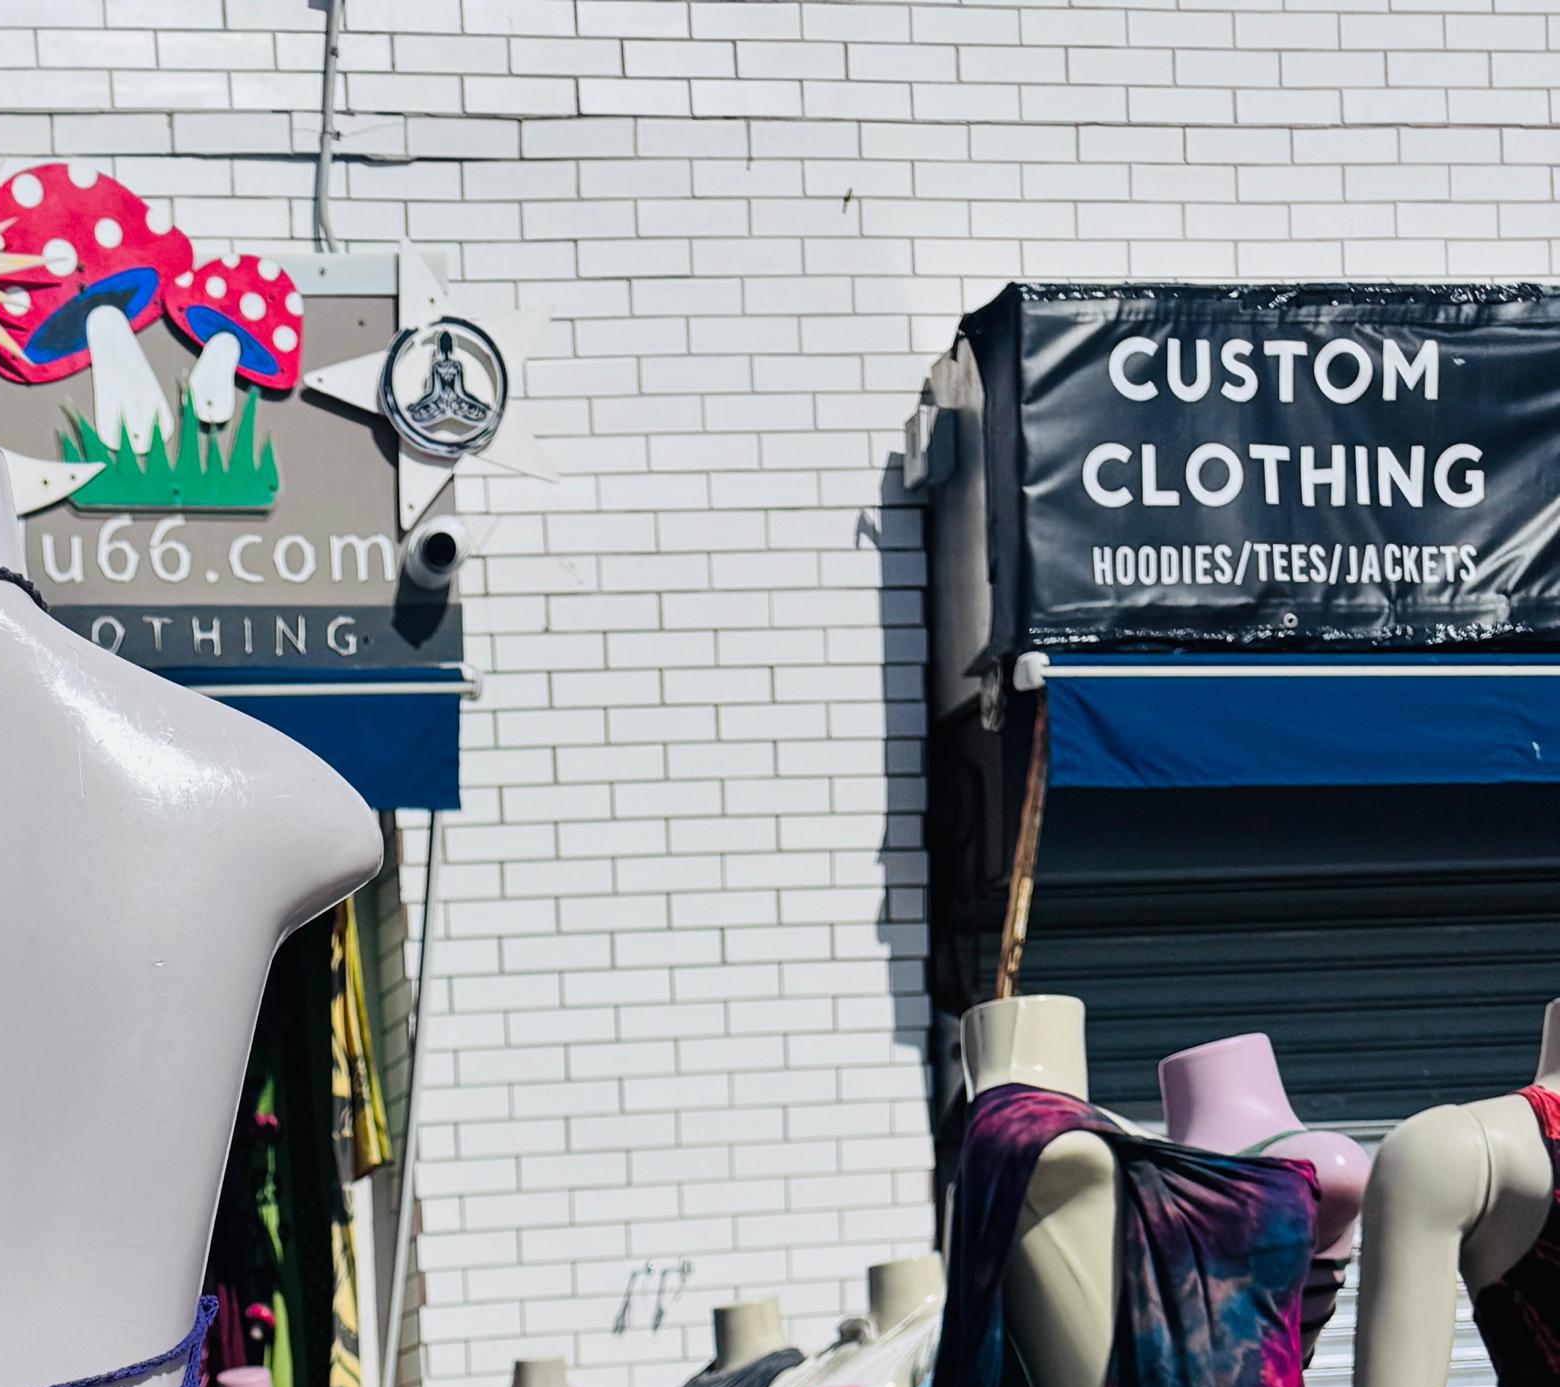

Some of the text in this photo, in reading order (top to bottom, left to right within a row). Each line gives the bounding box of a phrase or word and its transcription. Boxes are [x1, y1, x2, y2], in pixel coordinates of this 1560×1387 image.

[1108, 337, 1439, 404] CUSTOM
[1082, 442, 1485, 508] CLOTHING
[90, 614, 359, 656] OTHING
